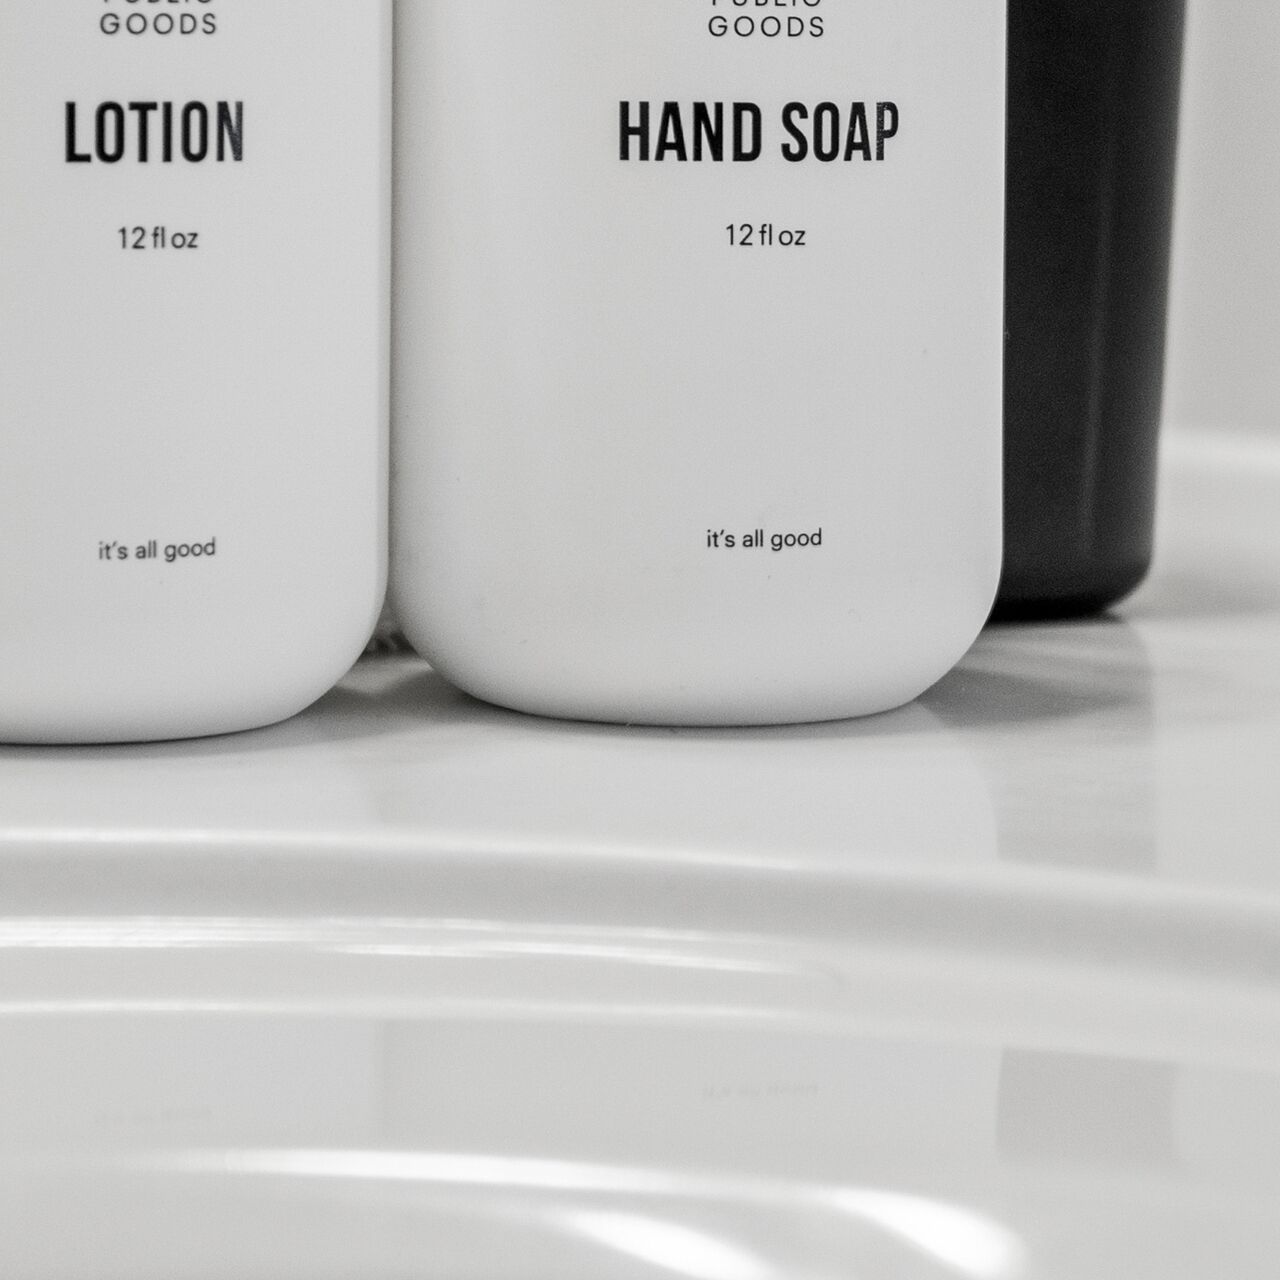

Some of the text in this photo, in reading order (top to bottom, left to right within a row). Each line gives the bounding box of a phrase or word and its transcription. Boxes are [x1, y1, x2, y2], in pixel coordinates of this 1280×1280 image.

[98, 11, 218, 36] GOODS
[706, 14, 825, 38] GOODS
[64, 100, 244, 165] LOTION
[618, 100, 900, 163] HAND SOAP
[117, 225, 199, 250] 12 fl oz
[725, 223, 807, 246] 12 fl oz
[98, 536, 217, 563] it's all good
[706, 526, 823, 552] it's all good
